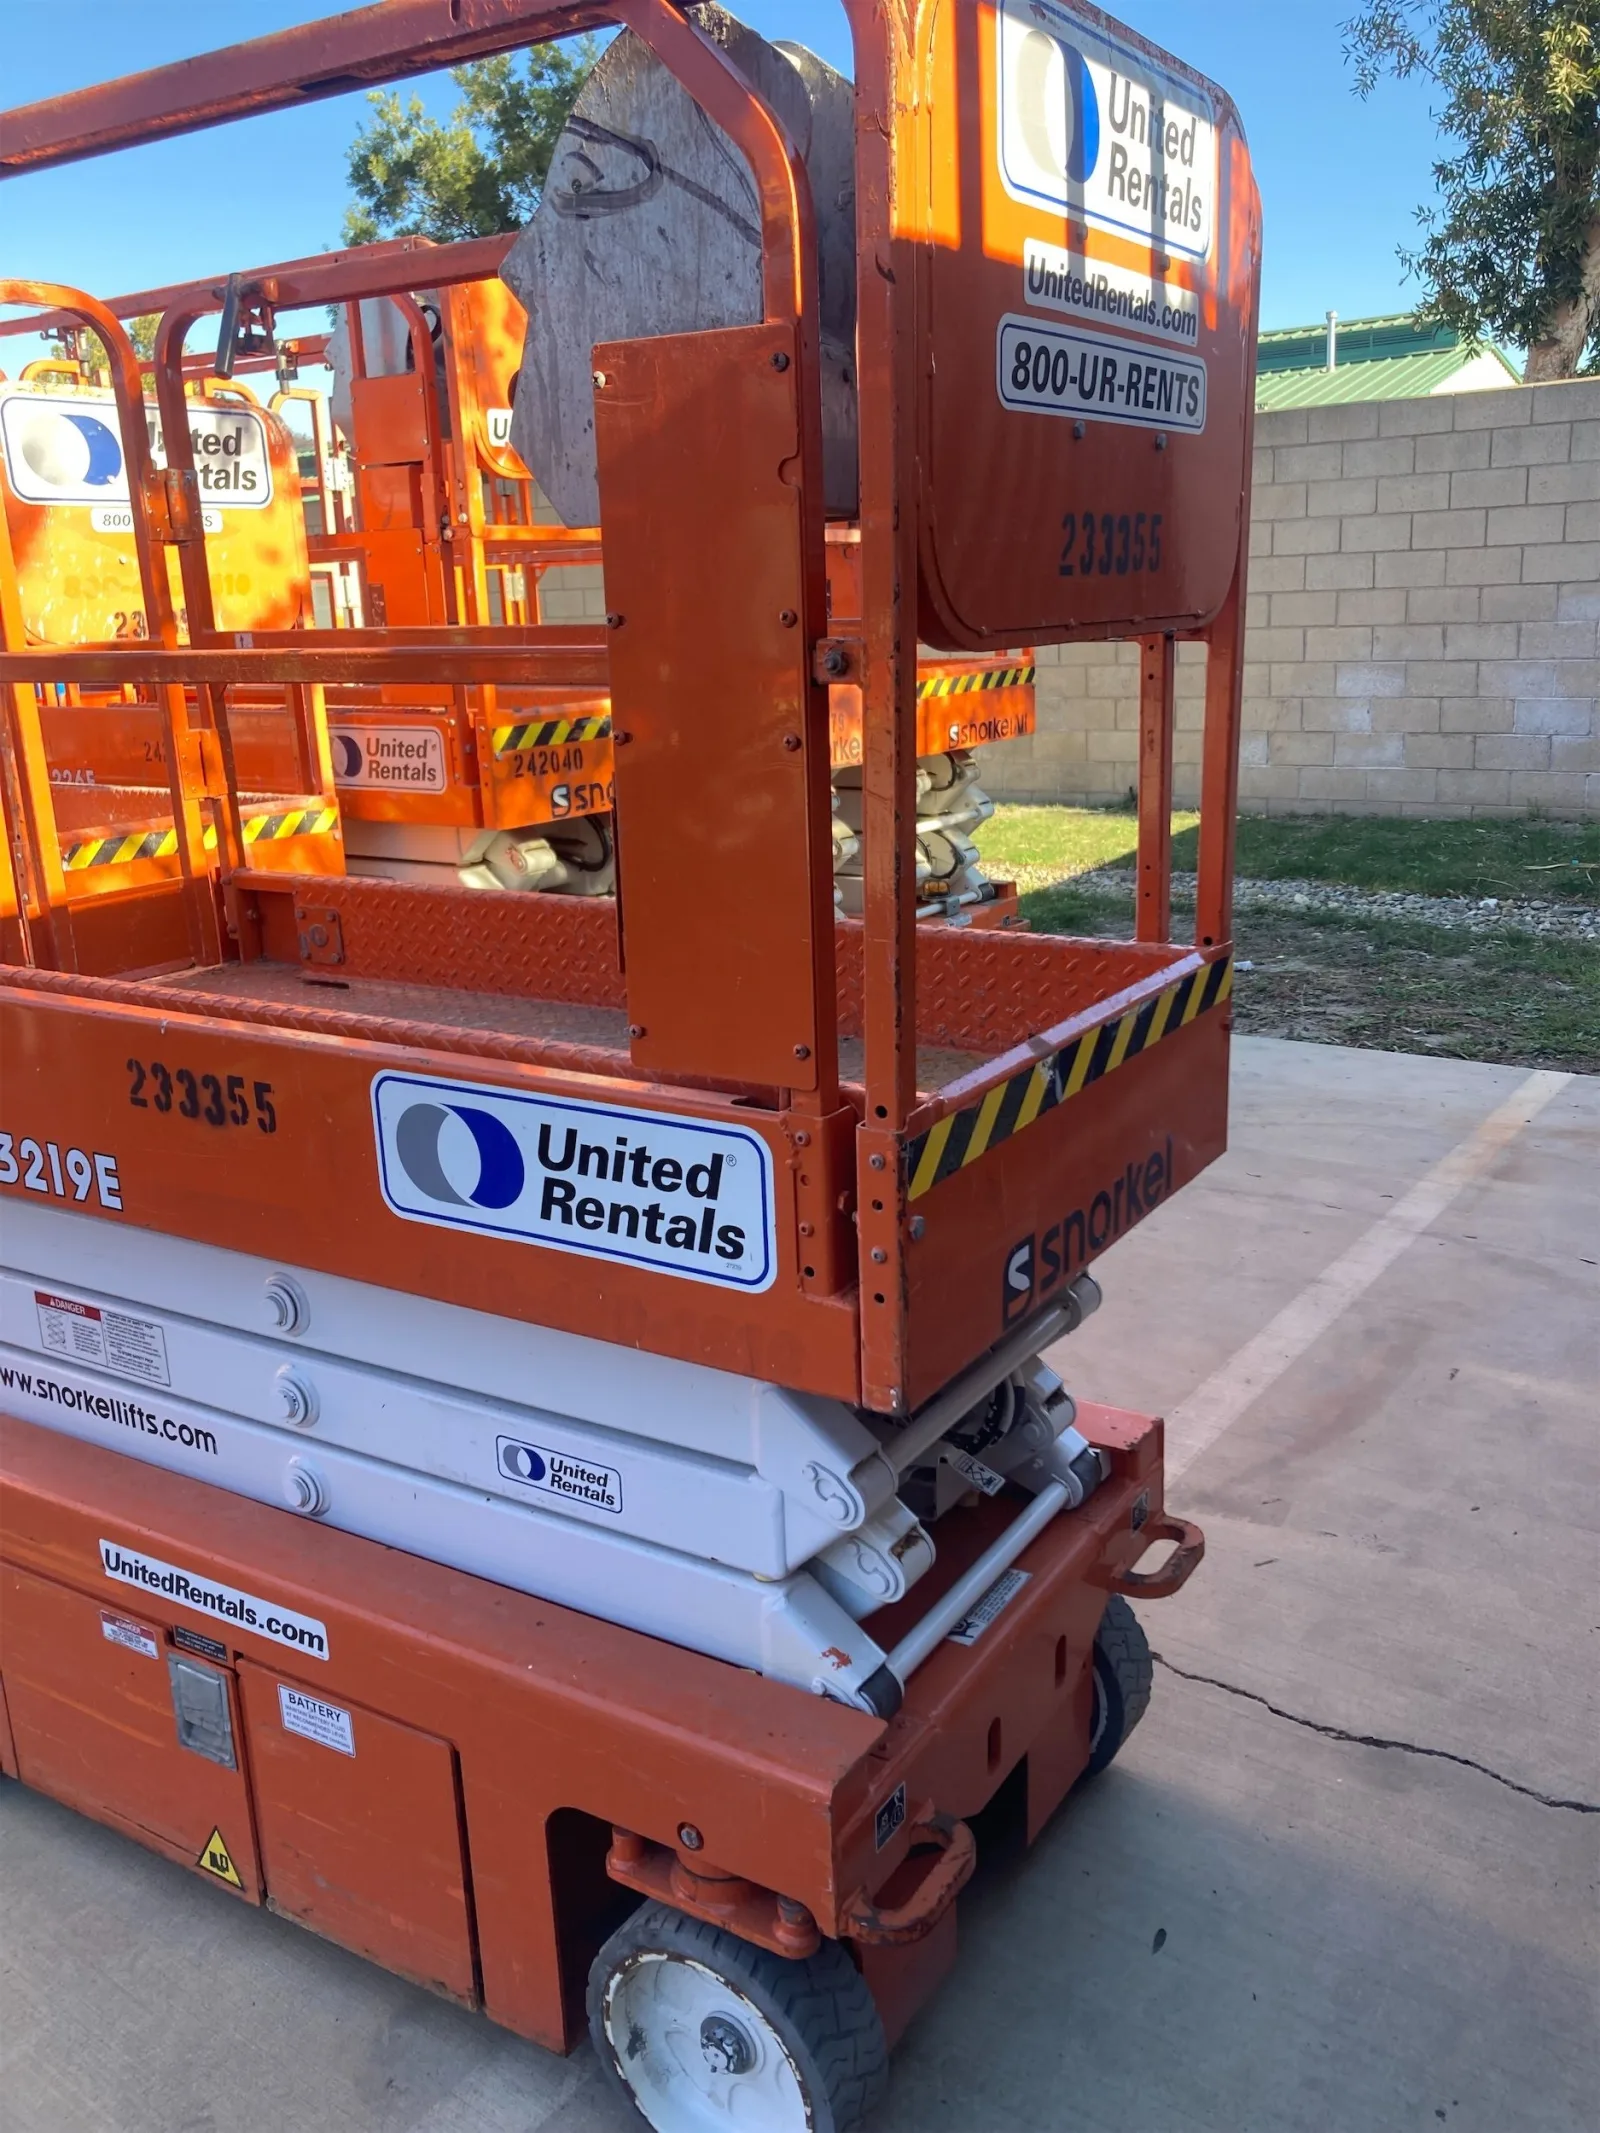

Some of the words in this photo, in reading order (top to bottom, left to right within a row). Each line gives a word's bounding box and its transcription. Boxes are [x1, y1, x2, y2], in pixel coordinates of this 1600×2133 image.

[1108, 71, 1197, 168] United
[1107, 141, 1202, 233] Rentals
[1028, 255, 1198, 337] UnitedRentals.com
[1011, 341, 1200, 417] 800-UR-RENTS
[1059, 511, 1162, 576] 233355
[366, 738, 428, 760] United
[368, 760, 437, 782] Rentals
[514, 748, 584, 778] 242040
[126, 1058, 277, 1133] 233355
[537, 1122, 724, 1201] United
[540, 1176, 746, 1260] Rentals
[1040, 1132, 1174, 1293] snorkel
[54, 1298, 86, 1315] DANGER
[550, 1457, 609, 1488] United
[550, 1474, 615, 1506] Rentals
[104, 1548, 324, 1652] UnitedRentals.com
[288, 1692, 341, 1723] BATTERY
